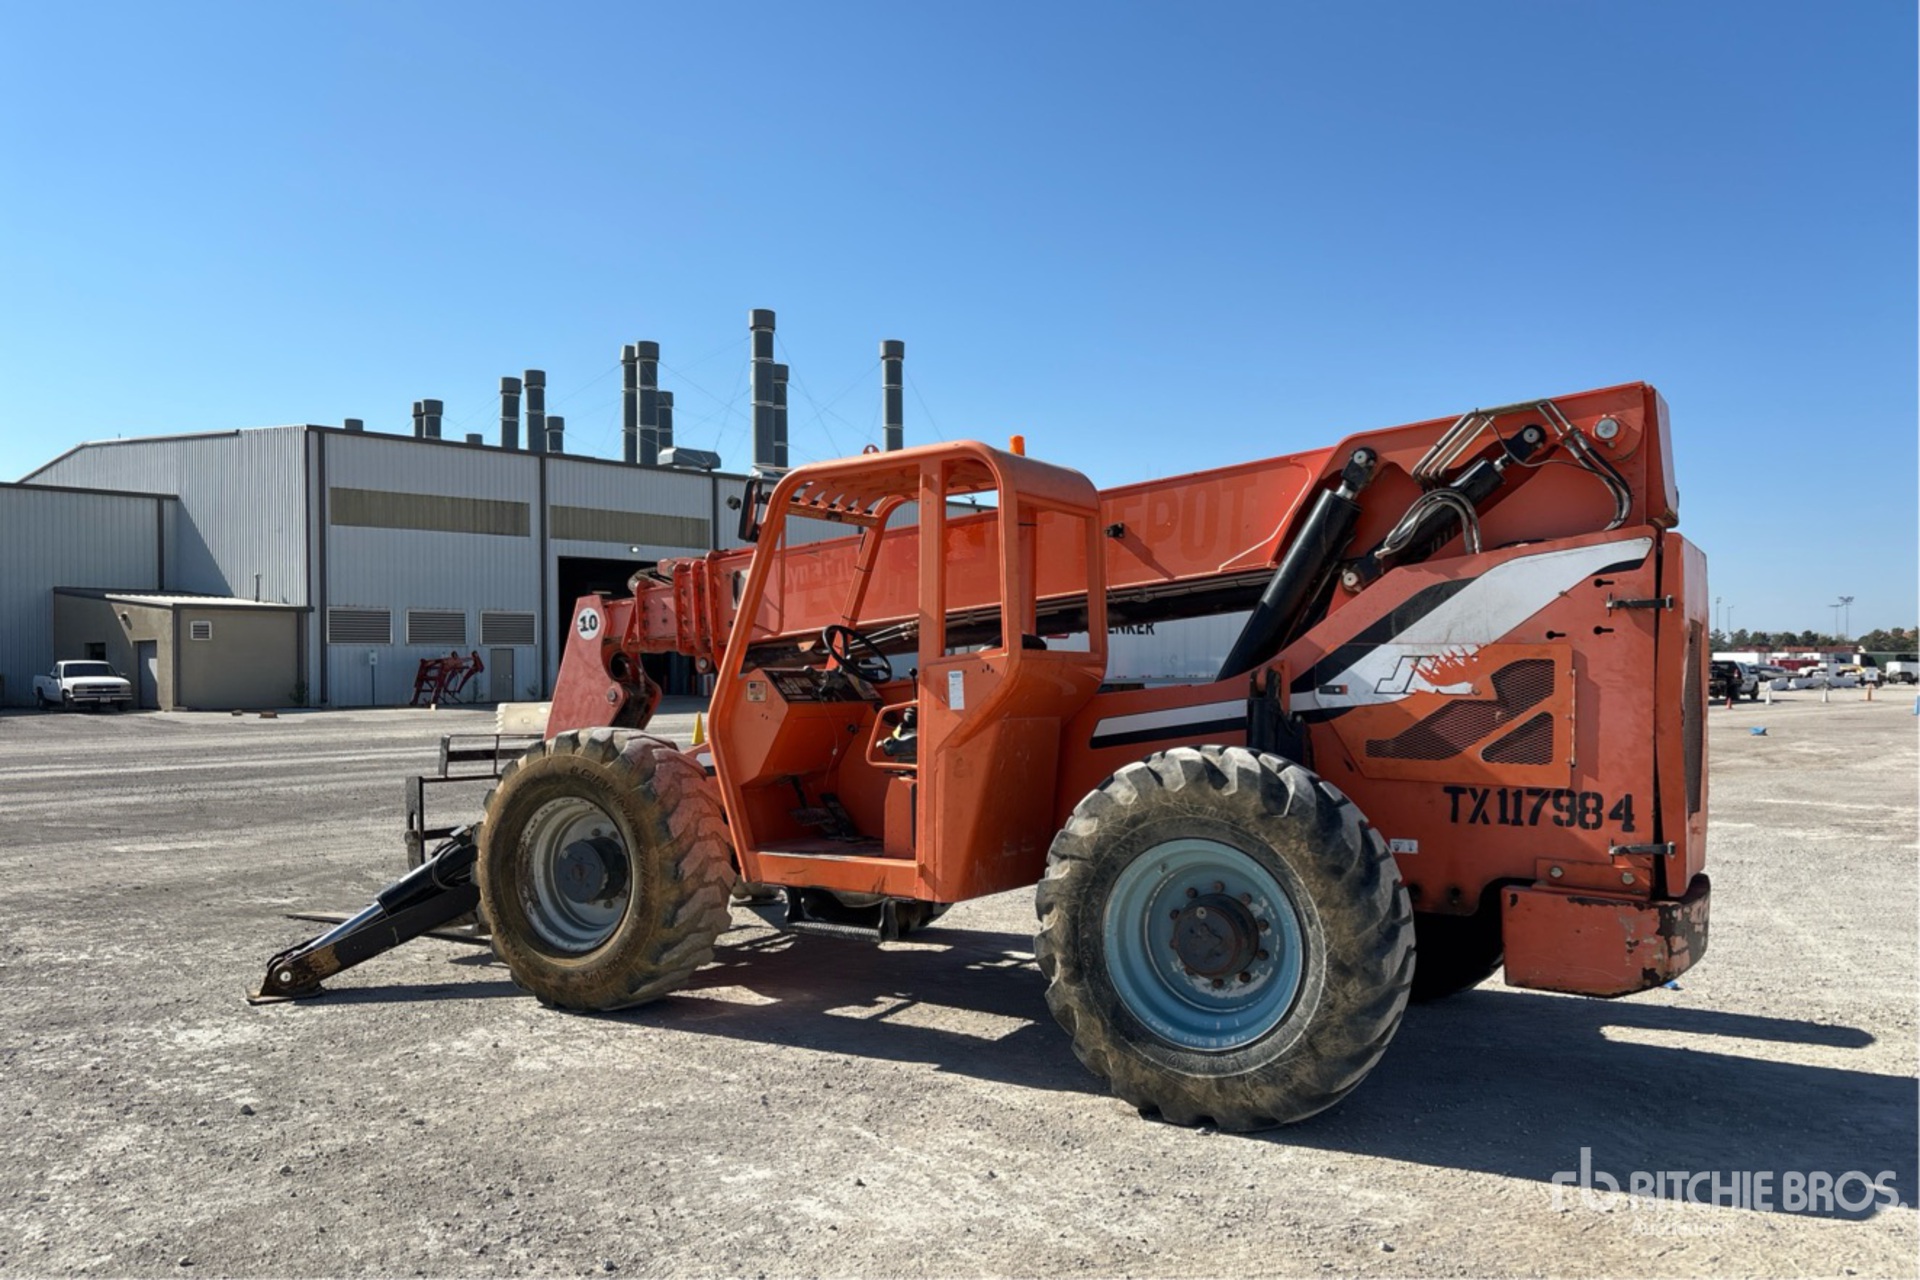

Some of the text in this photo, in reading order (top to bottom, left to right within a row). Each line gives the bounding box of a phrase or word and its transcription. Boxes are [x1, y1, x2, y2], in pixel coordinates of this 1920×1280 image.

[1100, 472, 1264, 573] EPOT
[579, 614, 599, 632] 10
[1443, 785, 1635, 832] TX117984
